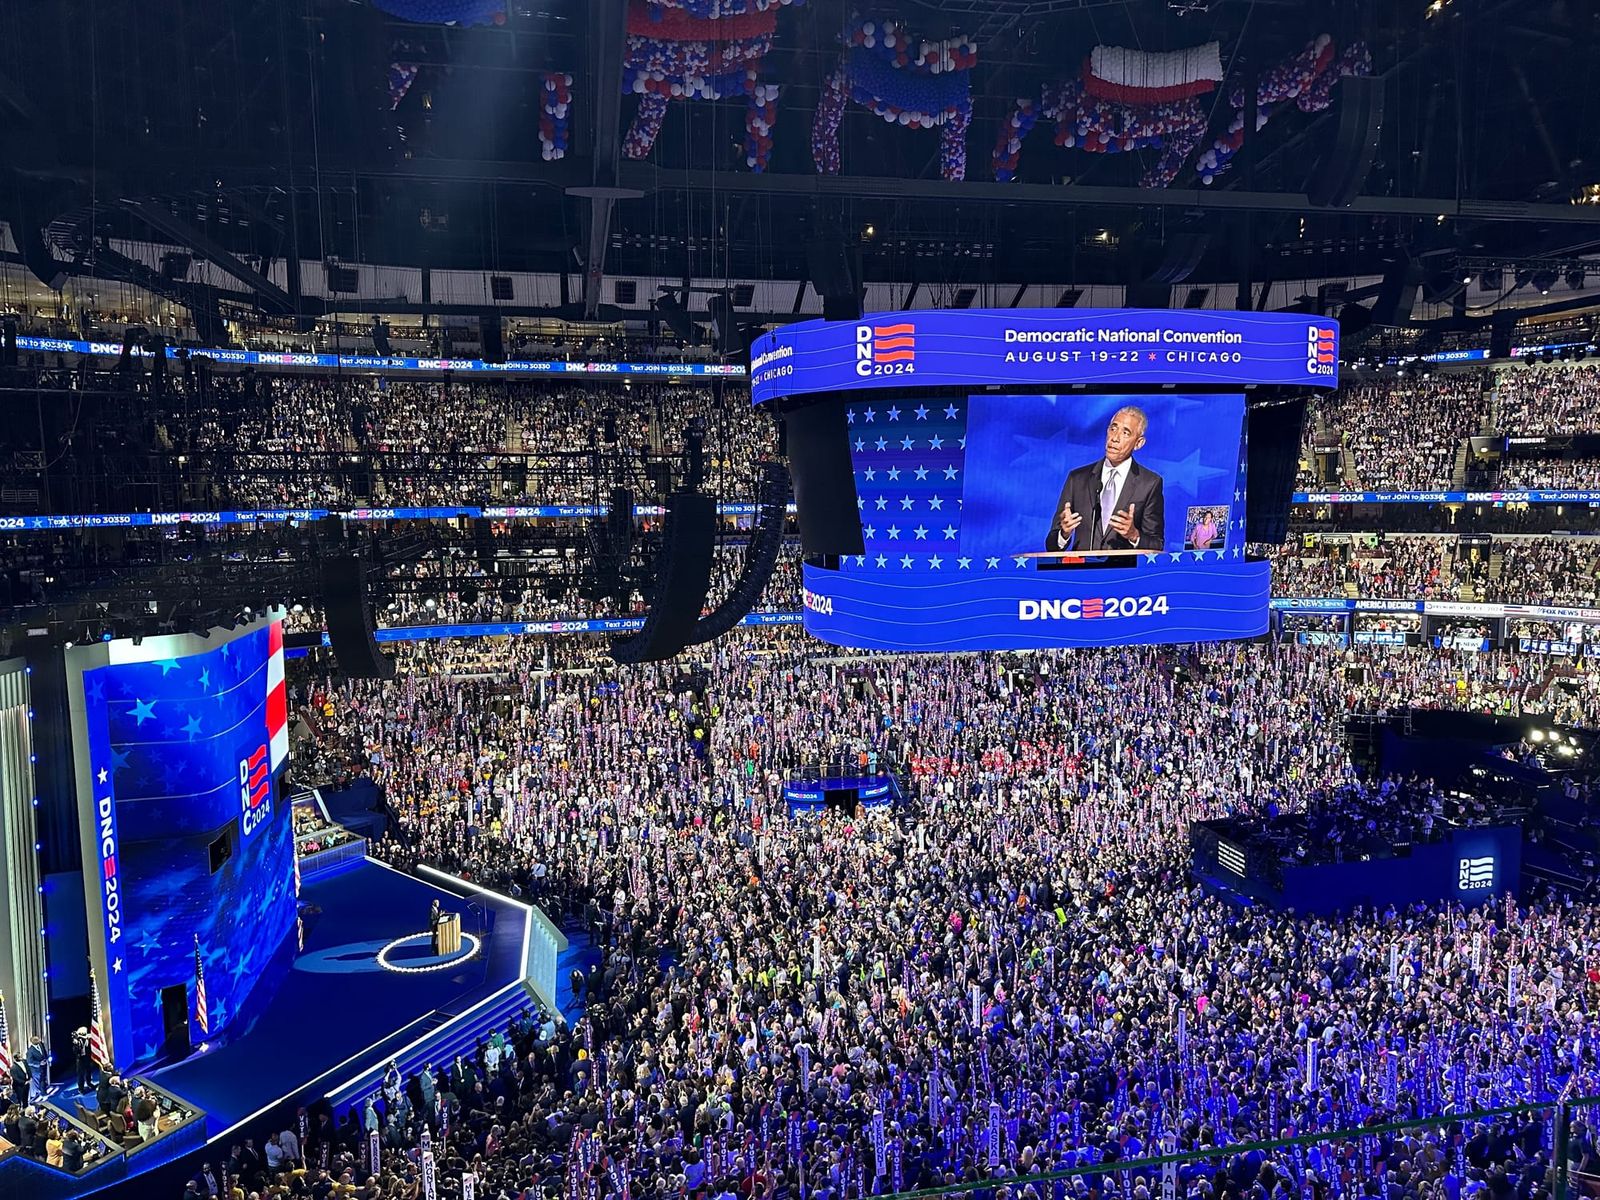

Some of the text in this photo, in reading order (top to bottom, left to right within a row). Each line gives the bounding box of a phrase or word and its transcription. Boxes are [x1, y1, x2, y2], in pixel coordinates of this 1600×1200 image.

[1005, 329, 1241, 344] Democratic National Convention
[91, 343, 118, 354] DNC
[221, 352, 246, 360] 30330
[258, 354, 319, 364] DNC 2024
[1005, 351, 1241, 363] AUGUST 19-22 CHICAGO
[1445, 352, 1469, 360] 30330
[418, 360, 473, 369] DNC 2024
[566, 363, 618, 372] DNC 2024
[875, 363, 915, 375] 2024
[764, 365, 793, 381] CHICAGO
[1317, 364, 1334, 376] 2024
[1308, 494, 1331, 502] DNC
[1467, 492, 1530, 501] DNC 2024
[367, 510, 394, 518] 2024
[574, 507, 592, 515] JOIN
[103, 516, 130, 524] 30330
[152, 512, 220, 524] DNC 2024
[811, 592, 833, 616] 2024
[1019, 596, 1169, 621] DNC 2024
[1299, 600, 1323, 608] NEWS
[1355, 601, 1417, 609] AMERICA DECIDES
[527, 622, 589, 632] DNC 2024
[605, 620, 640, 629] Text JOIN
[252, 799, 270, 828] 2024
[99, 797, 121, 944] DNC 2024
[1469, 880, 1492, 889] 2024
[1150, 1114, 1158, 1136] VOTE
[874, 1121, 883, 1167] VERMONT
[608, 1165, 622, 1193] VOTE
